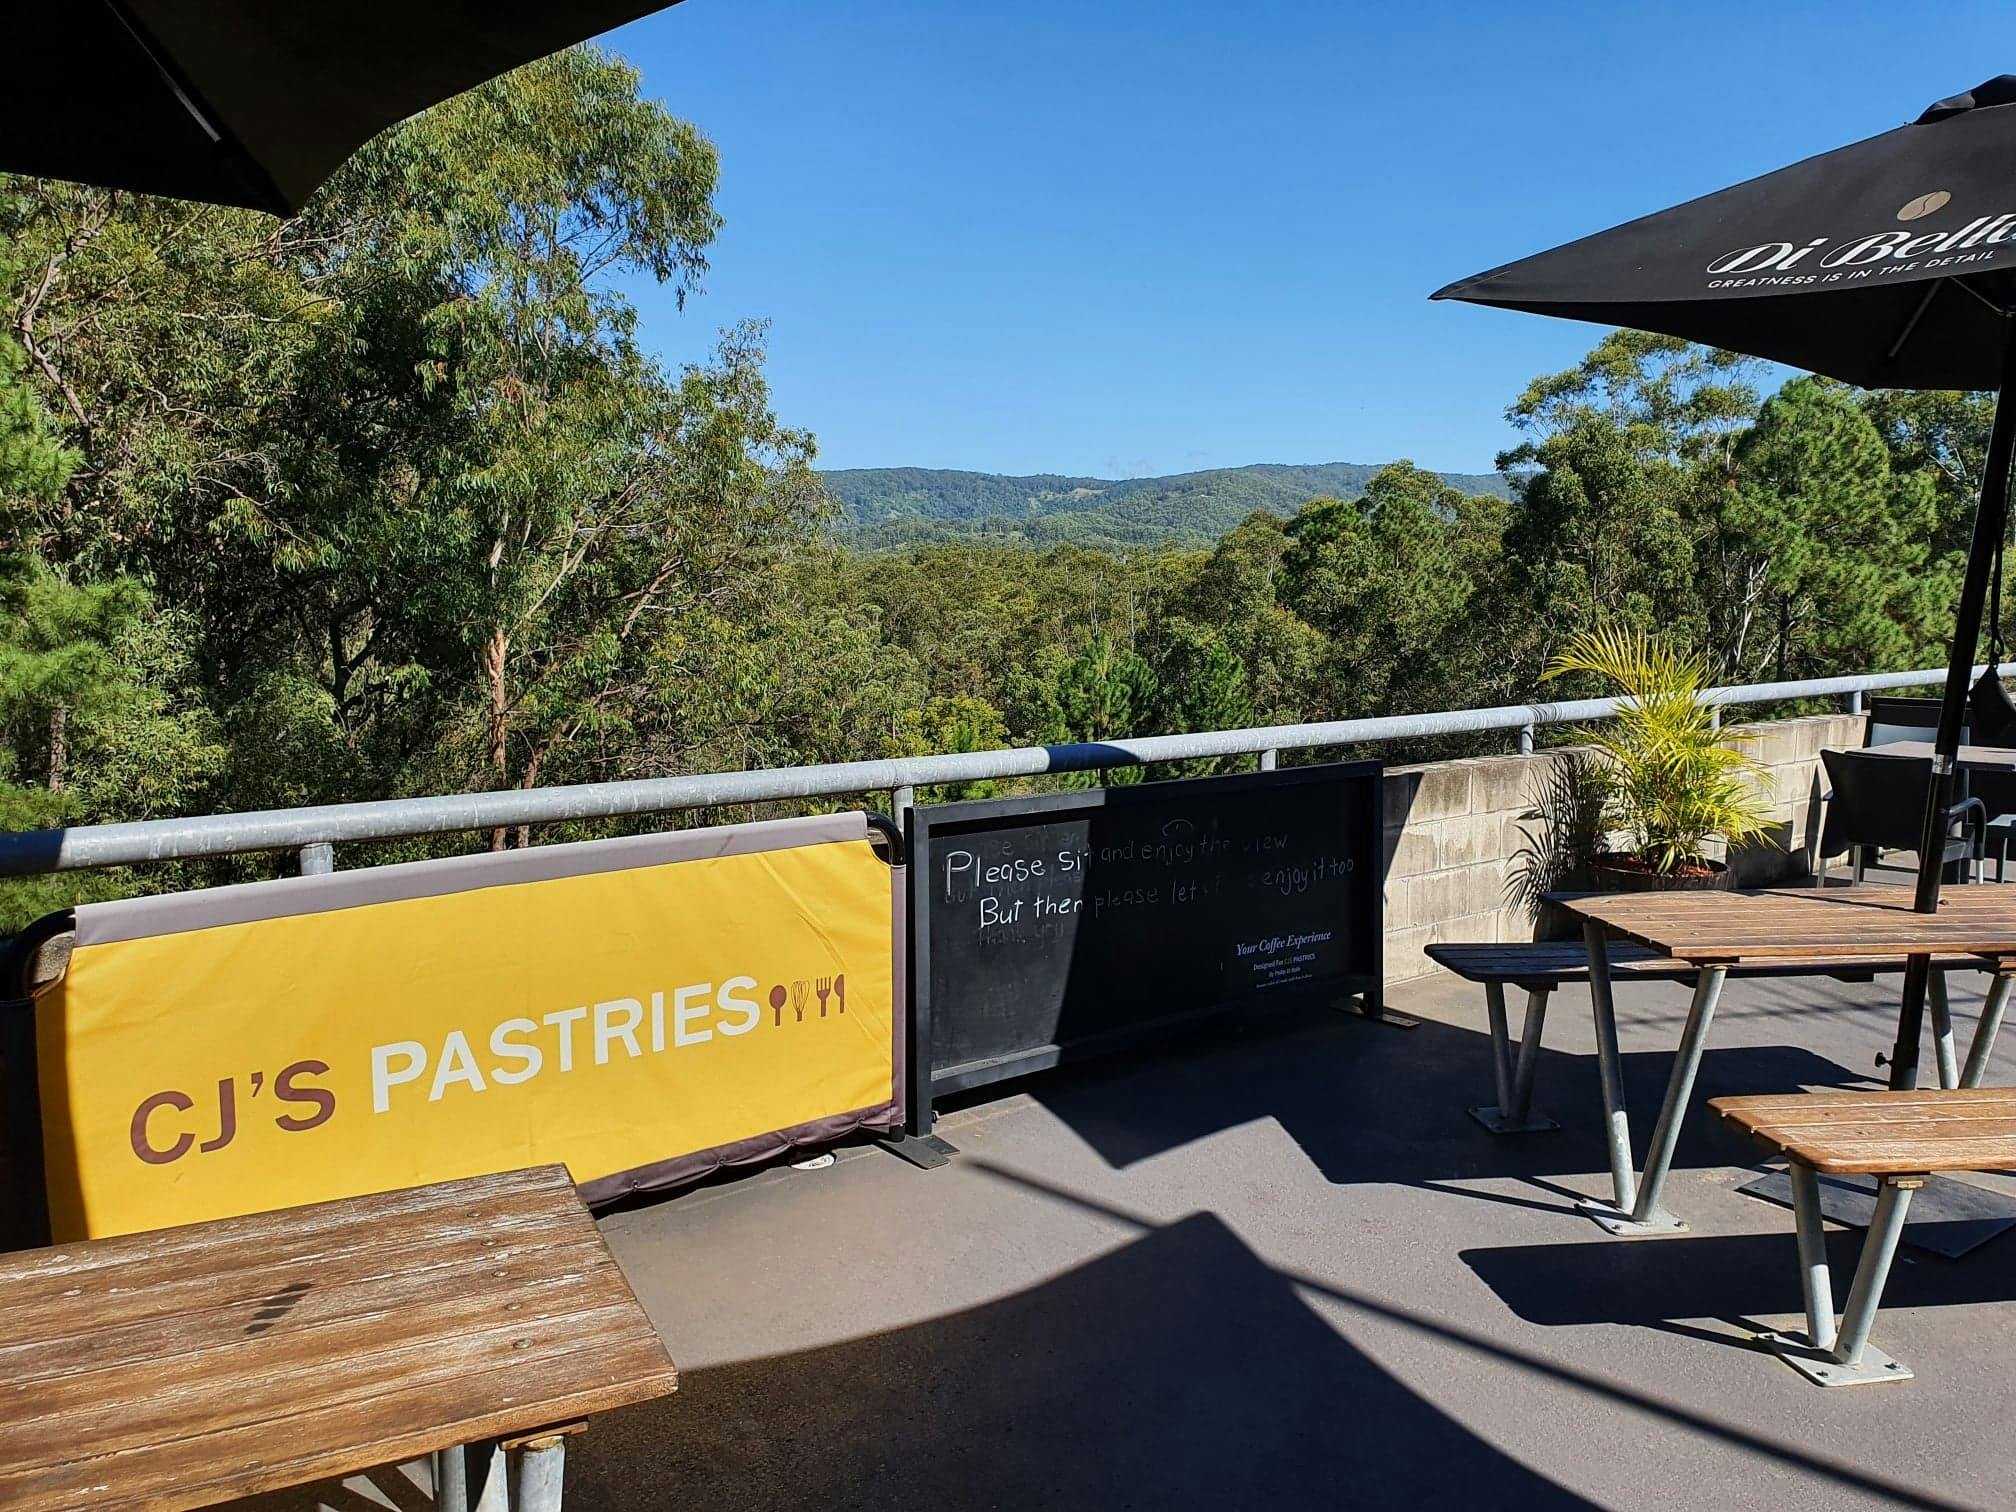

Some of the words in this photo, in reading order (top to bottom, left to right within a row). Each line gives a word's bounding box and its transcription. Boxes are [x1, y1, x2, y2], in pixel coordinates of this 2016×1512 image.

[1707, 238, 1829, 273] Di
[1708, 275, 1817, 289] GREATNESS
[1822, 272, 1843, 284] IS
[1849, 269, 1873, 280] IN
[1879, 262, 1918, 276] THE
[1925, 251, 1995, 269] DETAIL
[946, 850, 1046, 895] Please
[1100, 839, 1136, 863] and
[1141, 839, 1194, 866] enjoy
[1200, 832, 1232, 855] the
[980, 896, 1024, 929] But
[1033, 895, 1085, 919] then
[1095, 888, 1160, 918] please
[1263, 866, 1309, 895] enjoy
[1312, 857, 1325, 881] it
[1330, 857, 1355, 875] too
[1236, 944, 1258, 956] Your
[1259, 936, 1286, 954] Coffee
[1286, 931, 1332, 949] Experience
[131, 1060, 337, 1165] CJ'S
[371, 975, 761, 1113] PASTRIES
